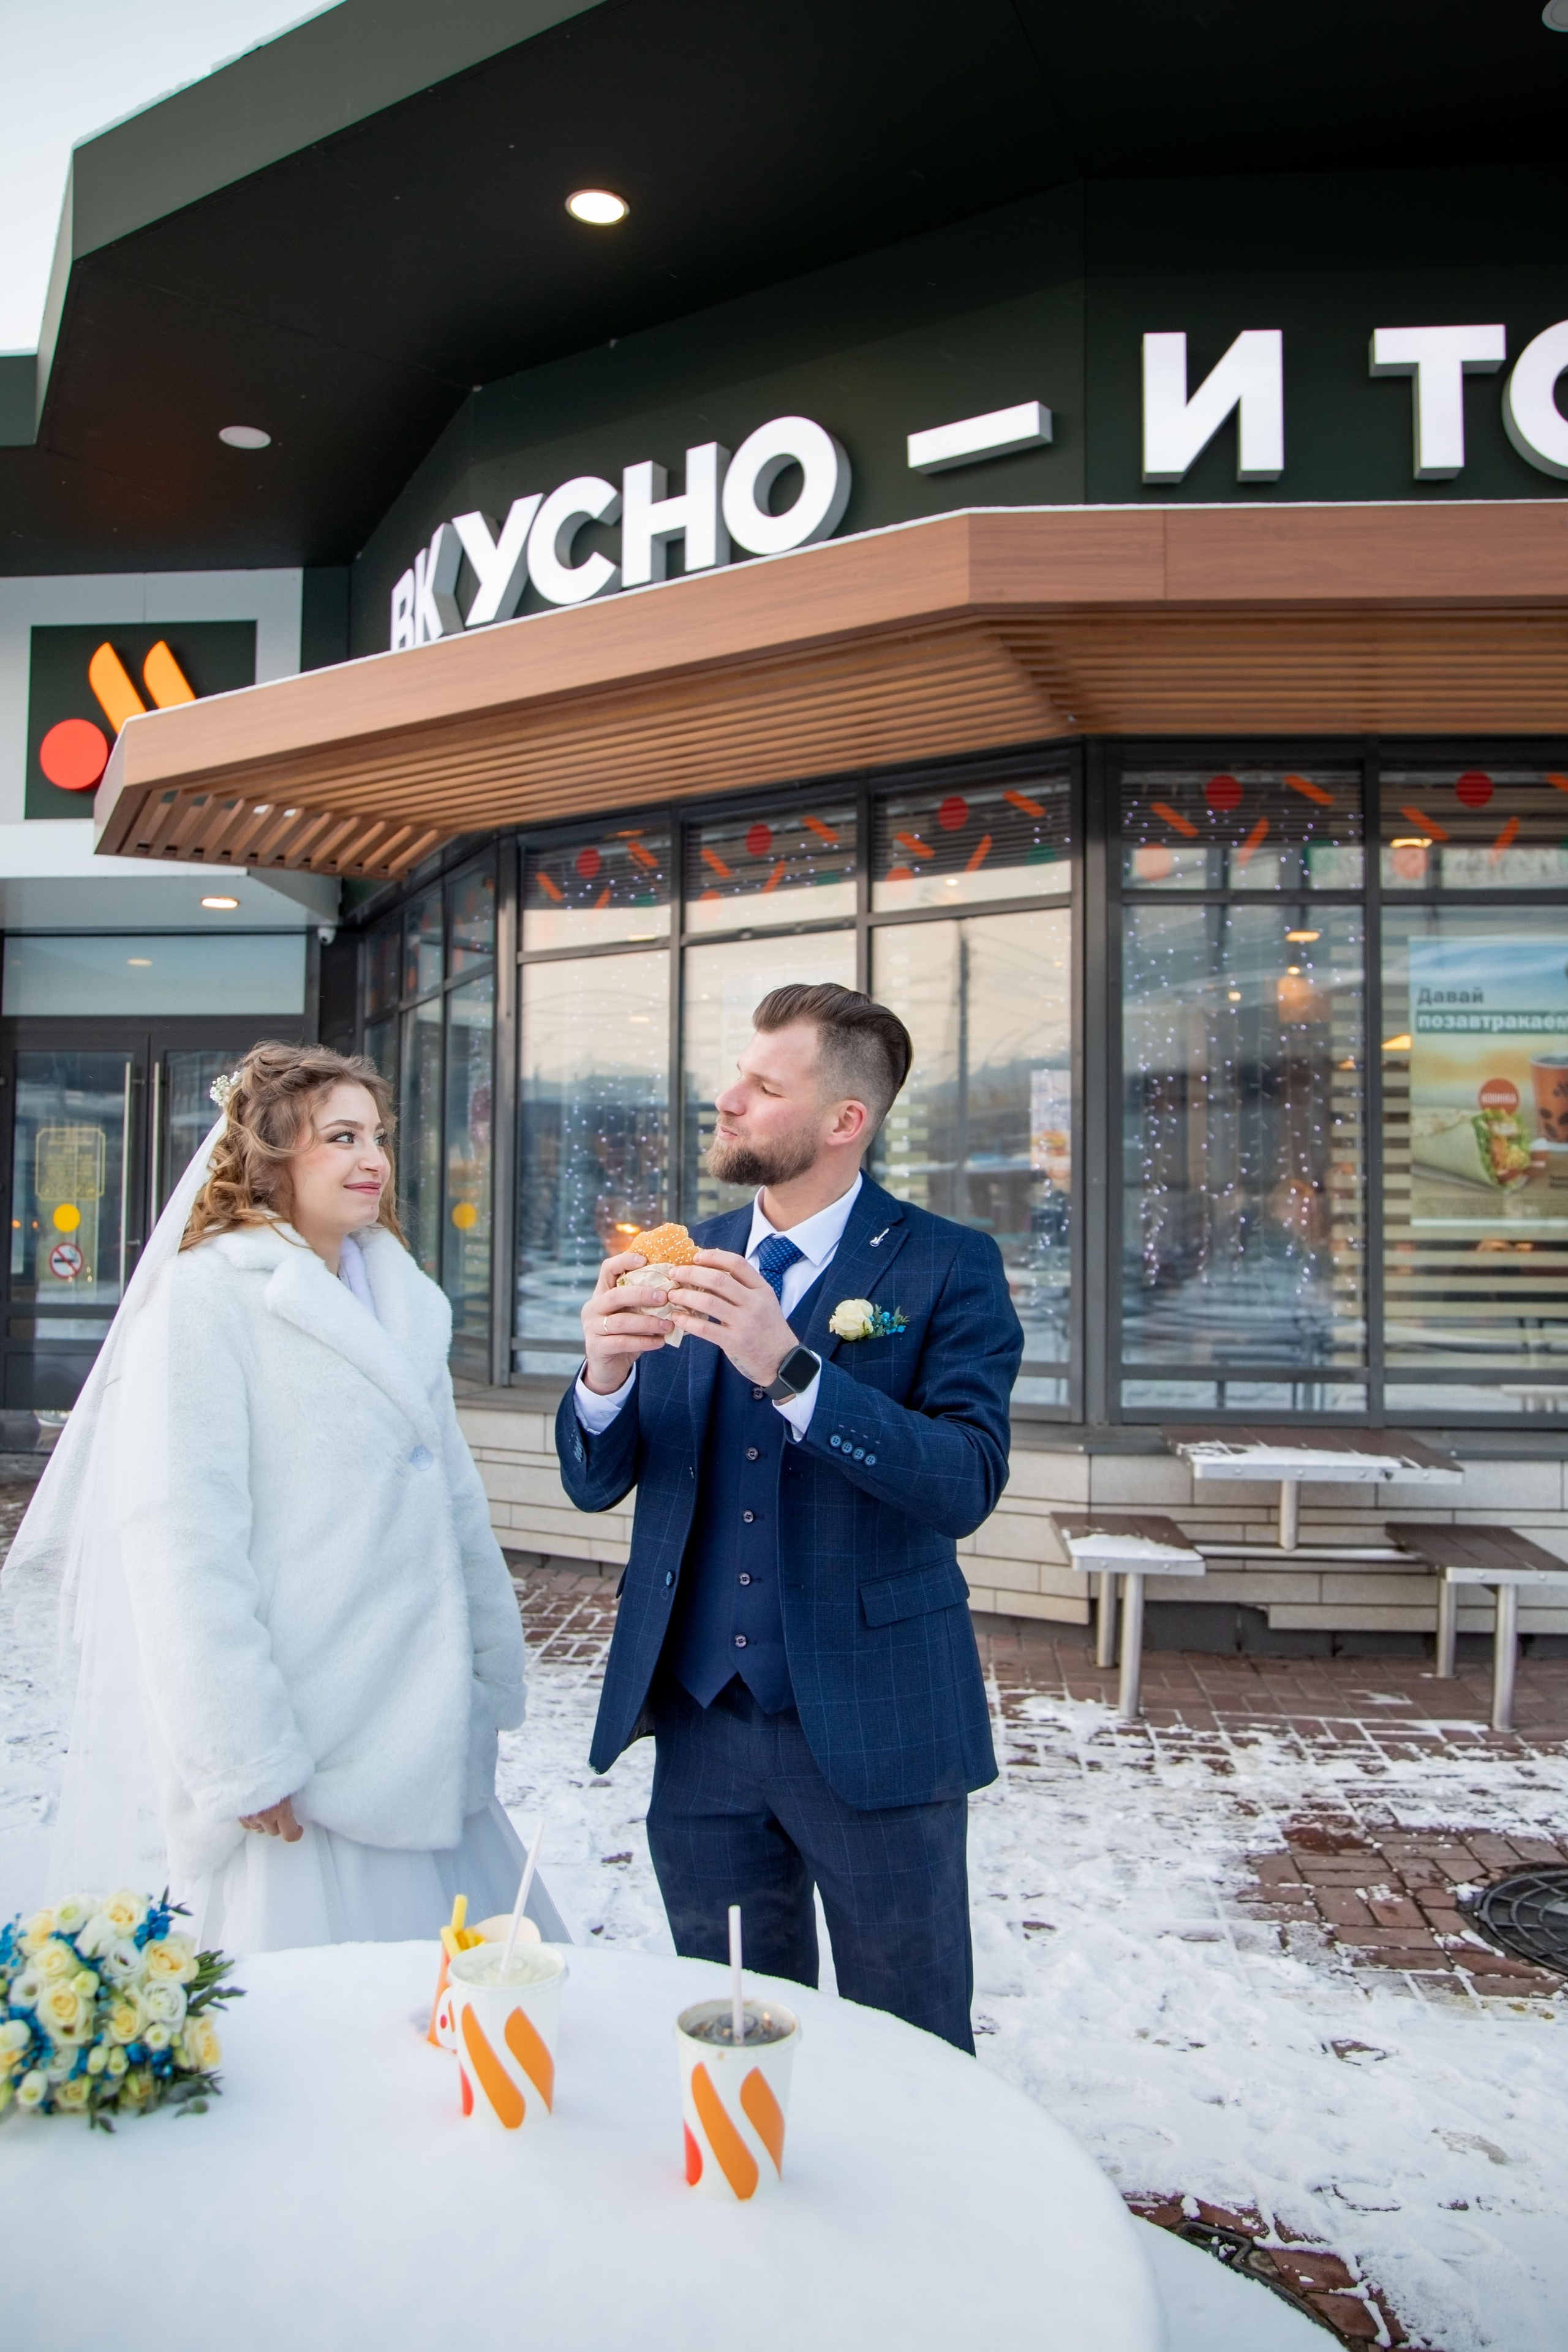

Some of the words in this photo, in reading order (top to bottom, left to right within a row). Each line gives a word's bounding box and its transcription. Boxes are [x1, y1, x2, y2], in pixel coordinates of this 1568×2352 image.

[390, 416, 851, 652] ВКУСНО
[1142, 329, 1284, 484] И
[1418, 986, 1484, 1006] Давай
